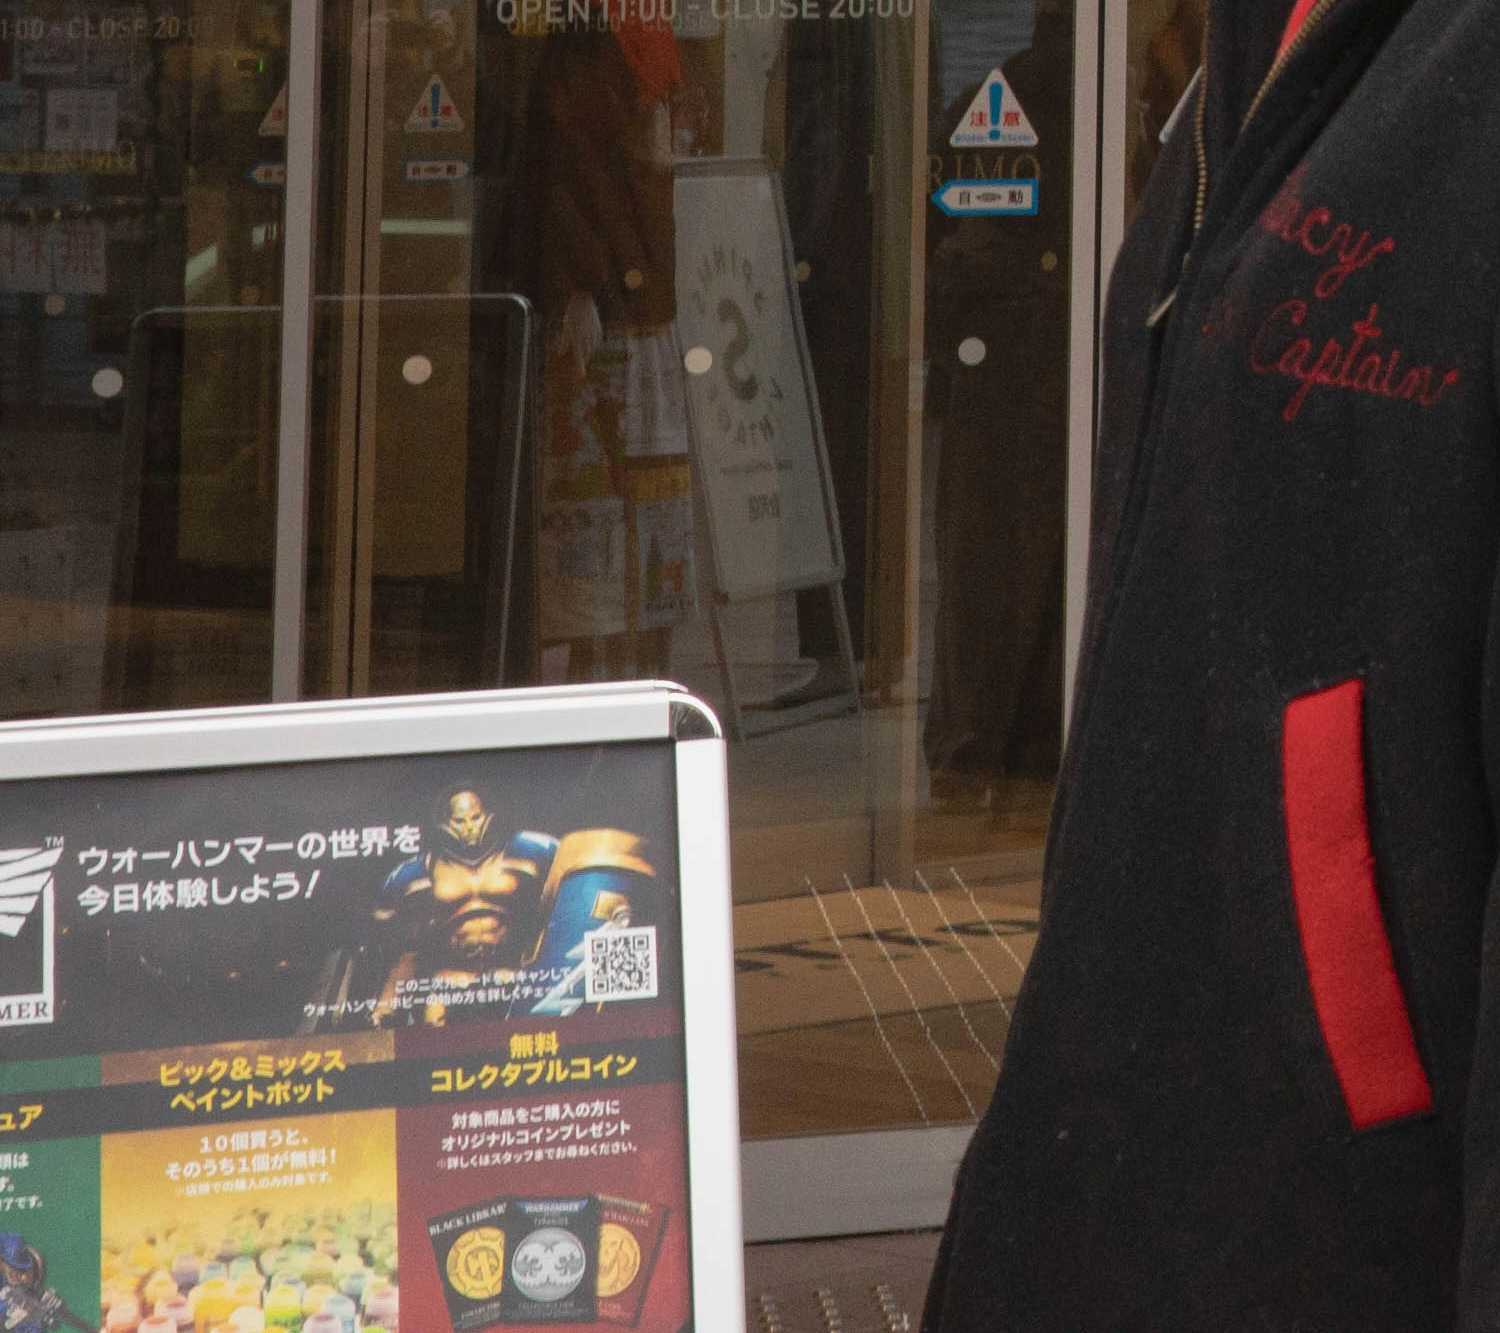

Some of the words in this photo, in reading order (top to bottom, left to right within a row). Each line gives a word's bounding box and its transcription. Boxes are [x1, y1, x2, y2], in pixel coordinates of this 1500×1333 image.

[77, 824, 422, 876] ウォーハンマーの世界を
[77, 869, 321, 917] 今日体験しよう！
[510, 1030, 560, 1060] 無料
[159, 1048, 346, 1087] ピック&ミックス
[431, 1054, 638, 1093] コレクタブルコイン
[170, 1076, 335, 1113] ペイントポット
[451, 1098, 621, 1131] 対象商品をご購入の方に
[441, 1119, 632, 1153] オリジナルコインプレゼント
[465, 1201, 507, 1229] LIBRAR
